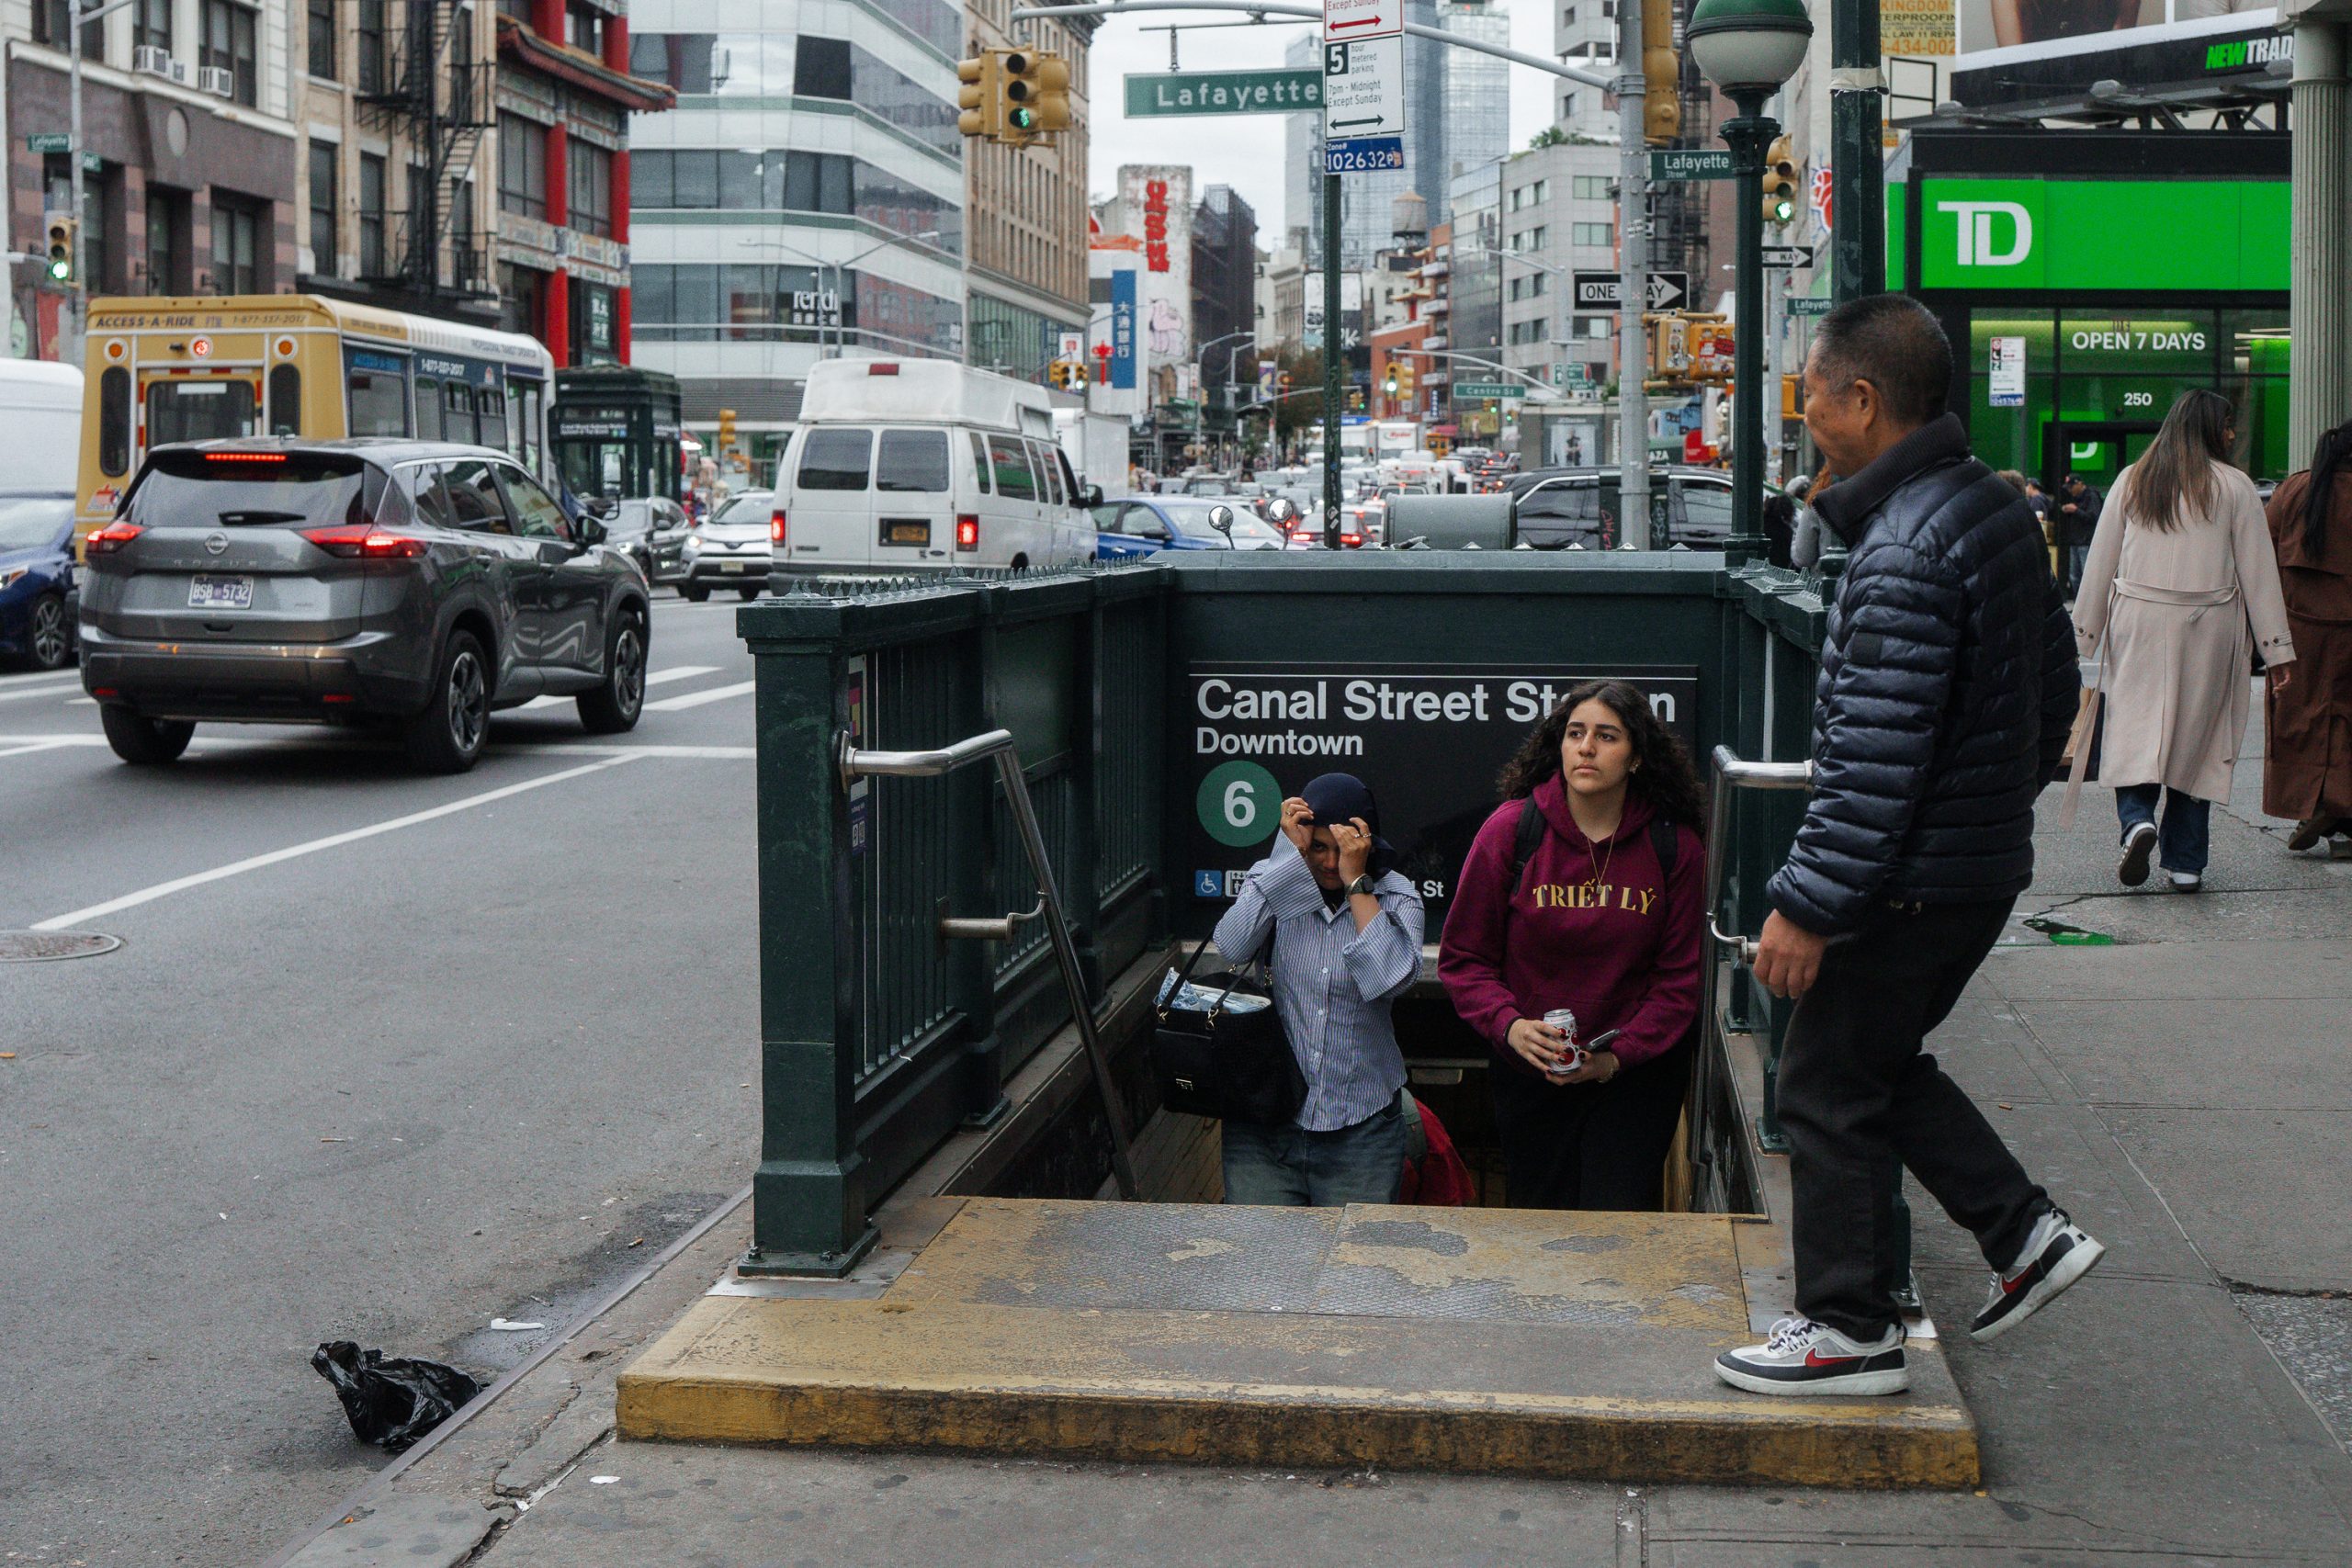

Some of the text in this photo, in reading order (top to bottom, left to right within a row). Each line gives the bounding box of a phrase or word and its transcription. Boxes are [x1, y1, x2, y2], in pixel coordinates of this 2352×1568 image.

[1328, 0, 1351, 11] Except
[1351, 43, 1365, 52] hour
[2205, 35, 2294, 70] NEWTRAD
[1329, 45, 1344, 74] 5
[1351, 53, 1377, 62] metered
[1351, 64, 1374, 75] parking
[1157, 79, 1319, 110] Lafayette
[1329, 85, 1344, 96] 7pm
[1351, 80, 1381, 93] Midnight
[1328, 94, 1383, 108] Except Sunday
[1327, 151, 1386, 171] 102632
[1664, 153, 1729, 172] Lafayette
[1937, 201, 2032, 265] TD
[1586, 285, 1666, 299] ONE AY
[96, 315, 197, 328] ACCESS-A-RIDE
[2072, 332, 2206, 351] OPEN 7 DAYS
[1466, 387, 1515, 397] Centre St
[2123, 392, 2153, 406] 250
[222, 583, 250, 600] 5732
[1197, 679, 1328, 721] Canal
[1343, 680, 1490, 723] Street
[1197, 727, 1364, 756] Downtown
[1223, 780, 1256, 828] 6
[1422, 880, 1444, 898] St
[1532, 878, 1657, 916] TRIẾT LÝ
